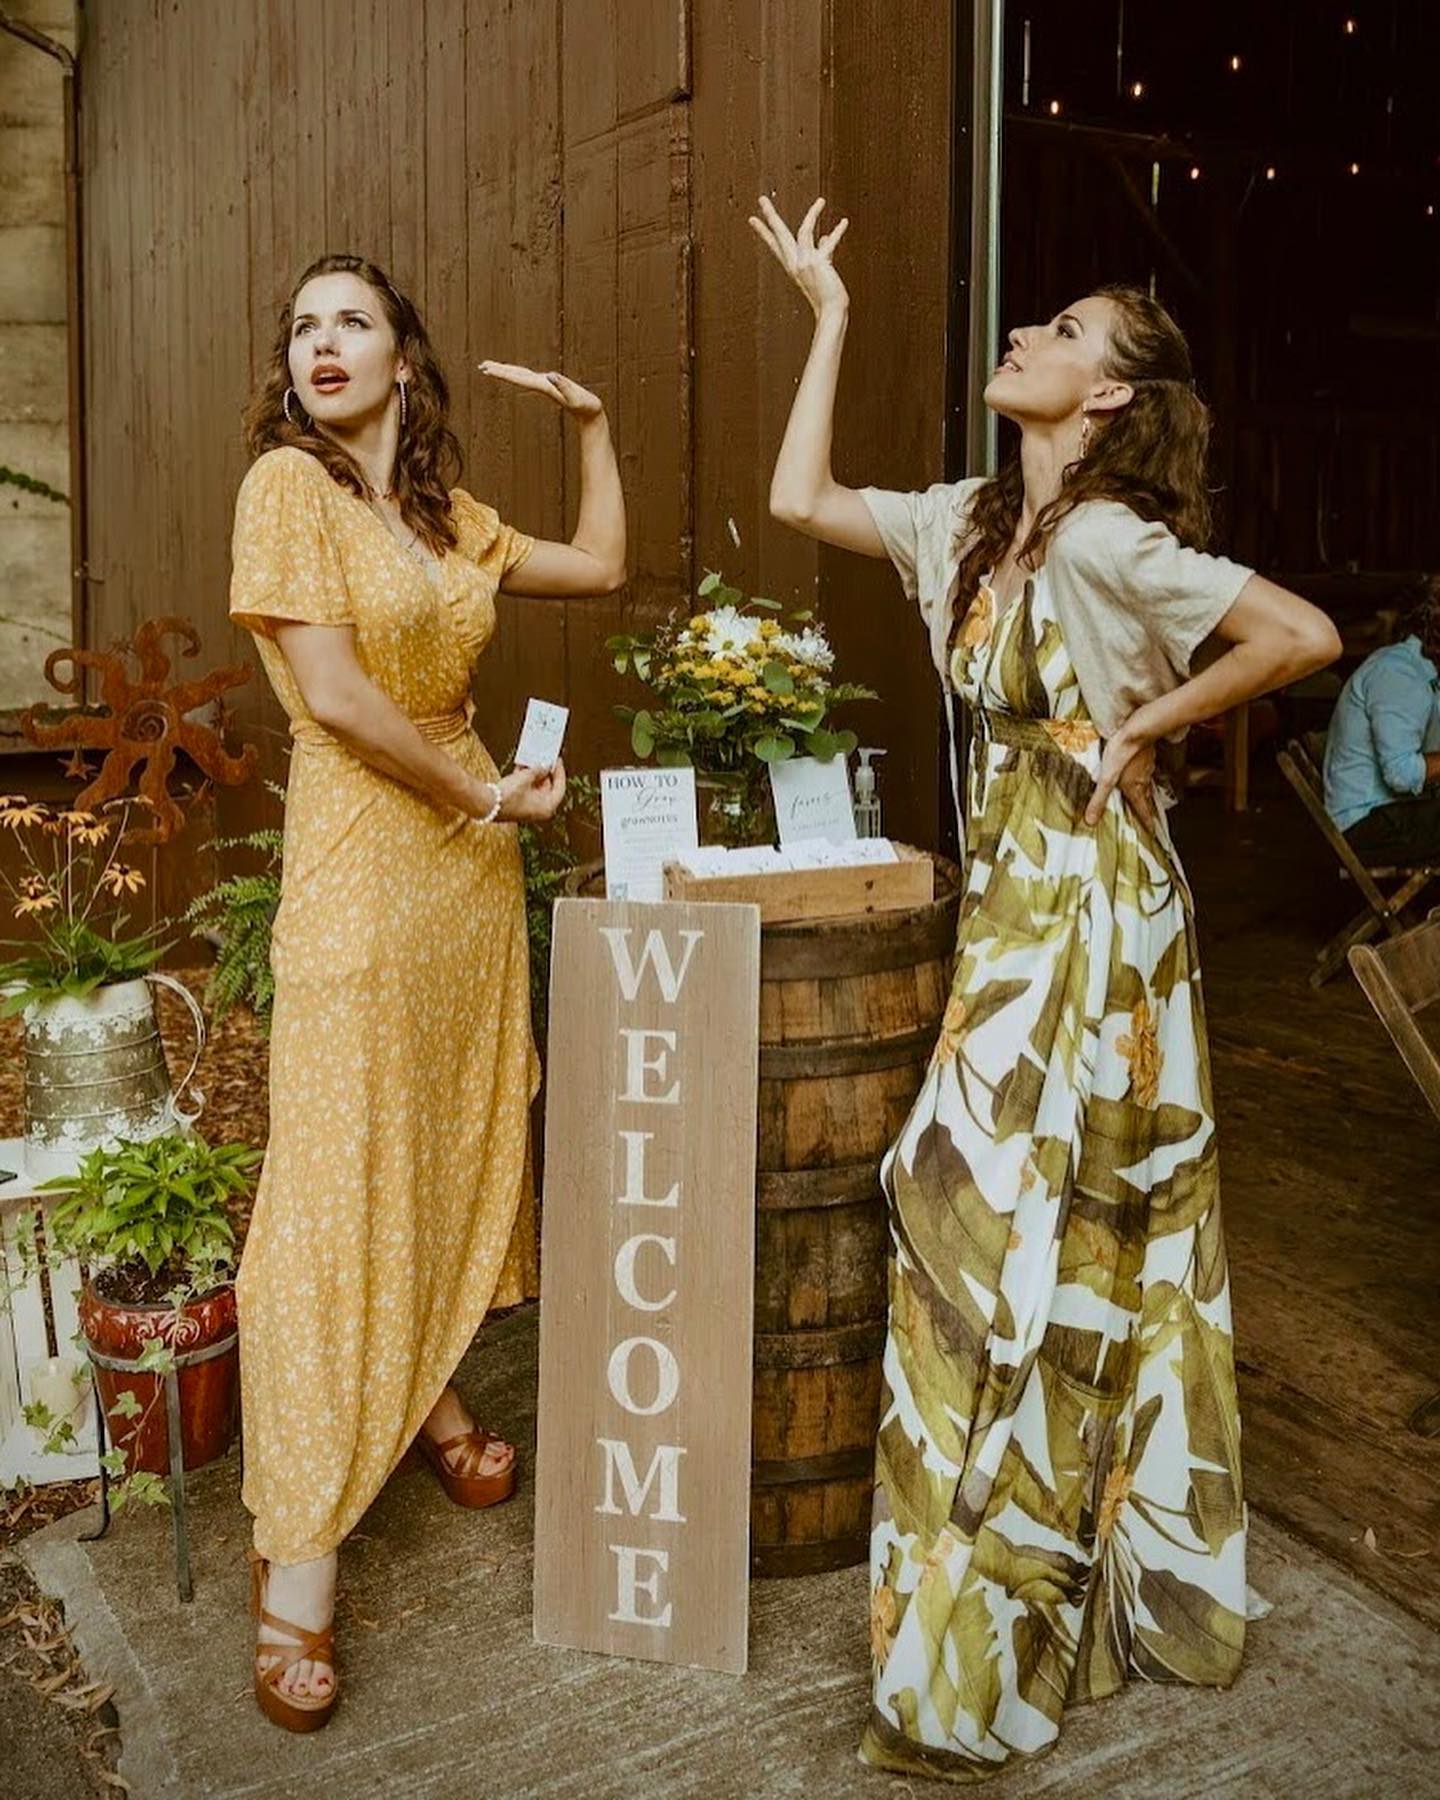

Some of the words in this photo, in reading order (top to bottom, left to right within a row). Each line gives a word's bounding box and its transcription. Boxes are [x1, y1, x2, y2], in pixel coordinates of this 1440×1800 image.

[607, 775, 646, 790] HOW
[654, 774, 679, 789] TO
[595, 927, 704, 1628] WELCOME
